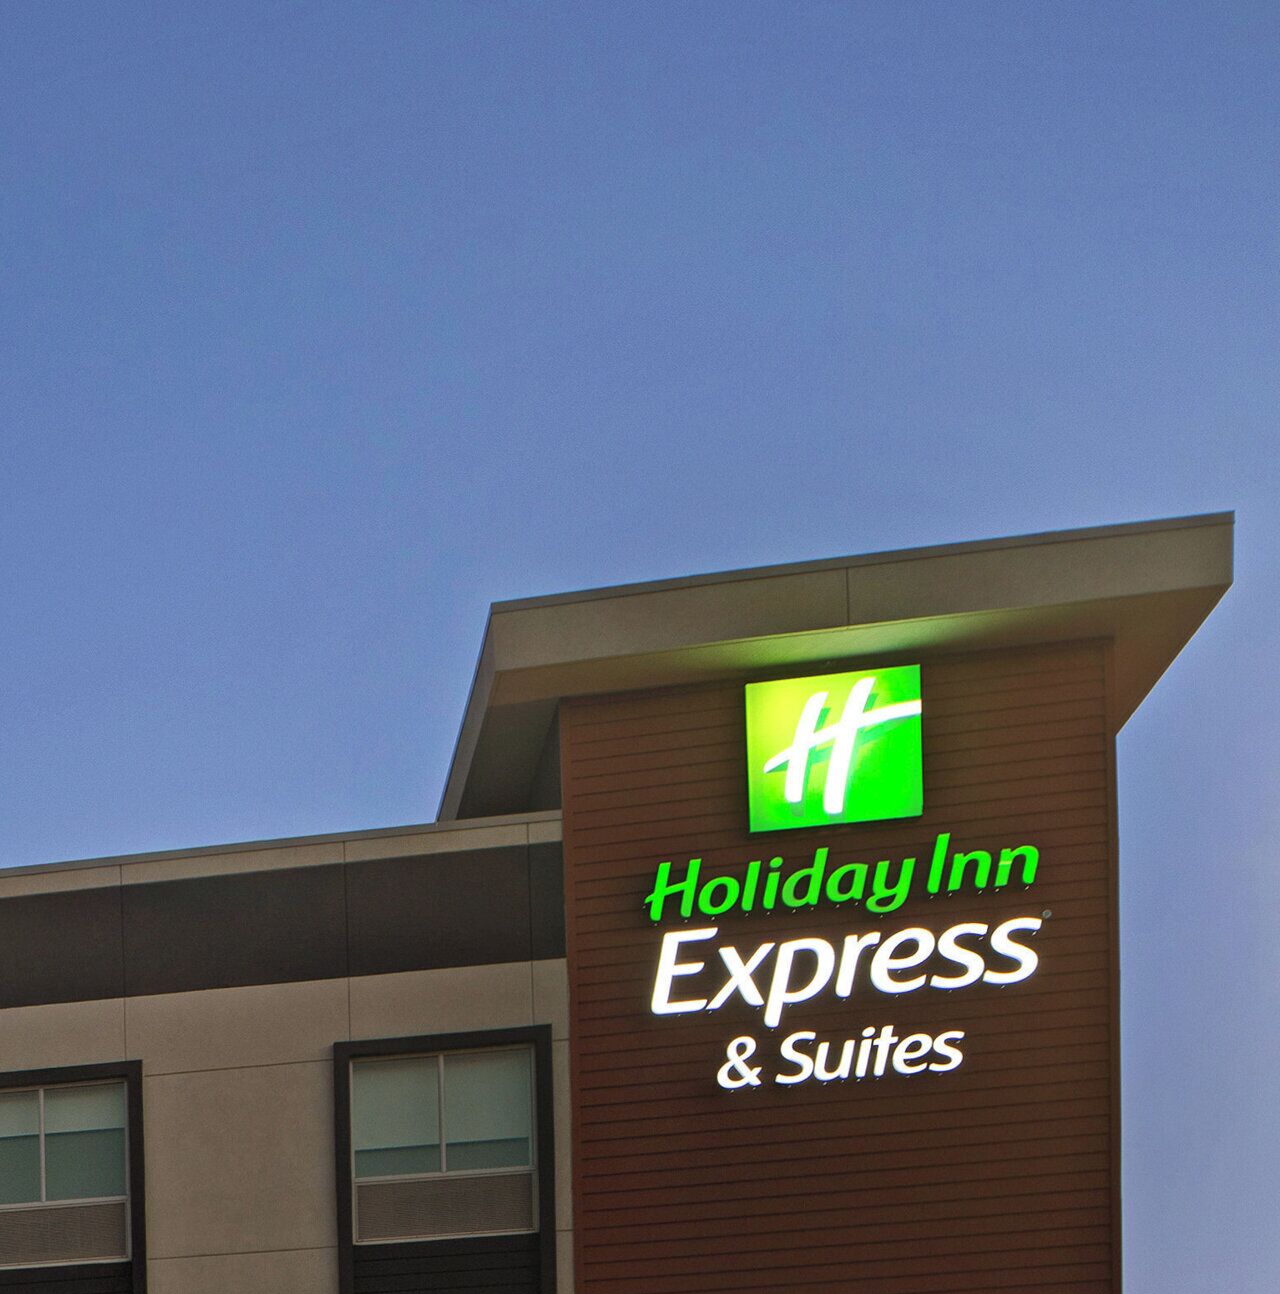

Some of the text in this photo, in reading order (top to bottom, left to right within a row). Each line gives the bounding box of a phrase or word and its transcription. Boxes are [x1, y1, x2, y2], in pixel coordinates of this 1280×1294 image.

[644, 832, 1040, 922] Holiday Inn
[650, 916, 1043, 1028] Express
[716, 1025, 966, 1089] & Suites
